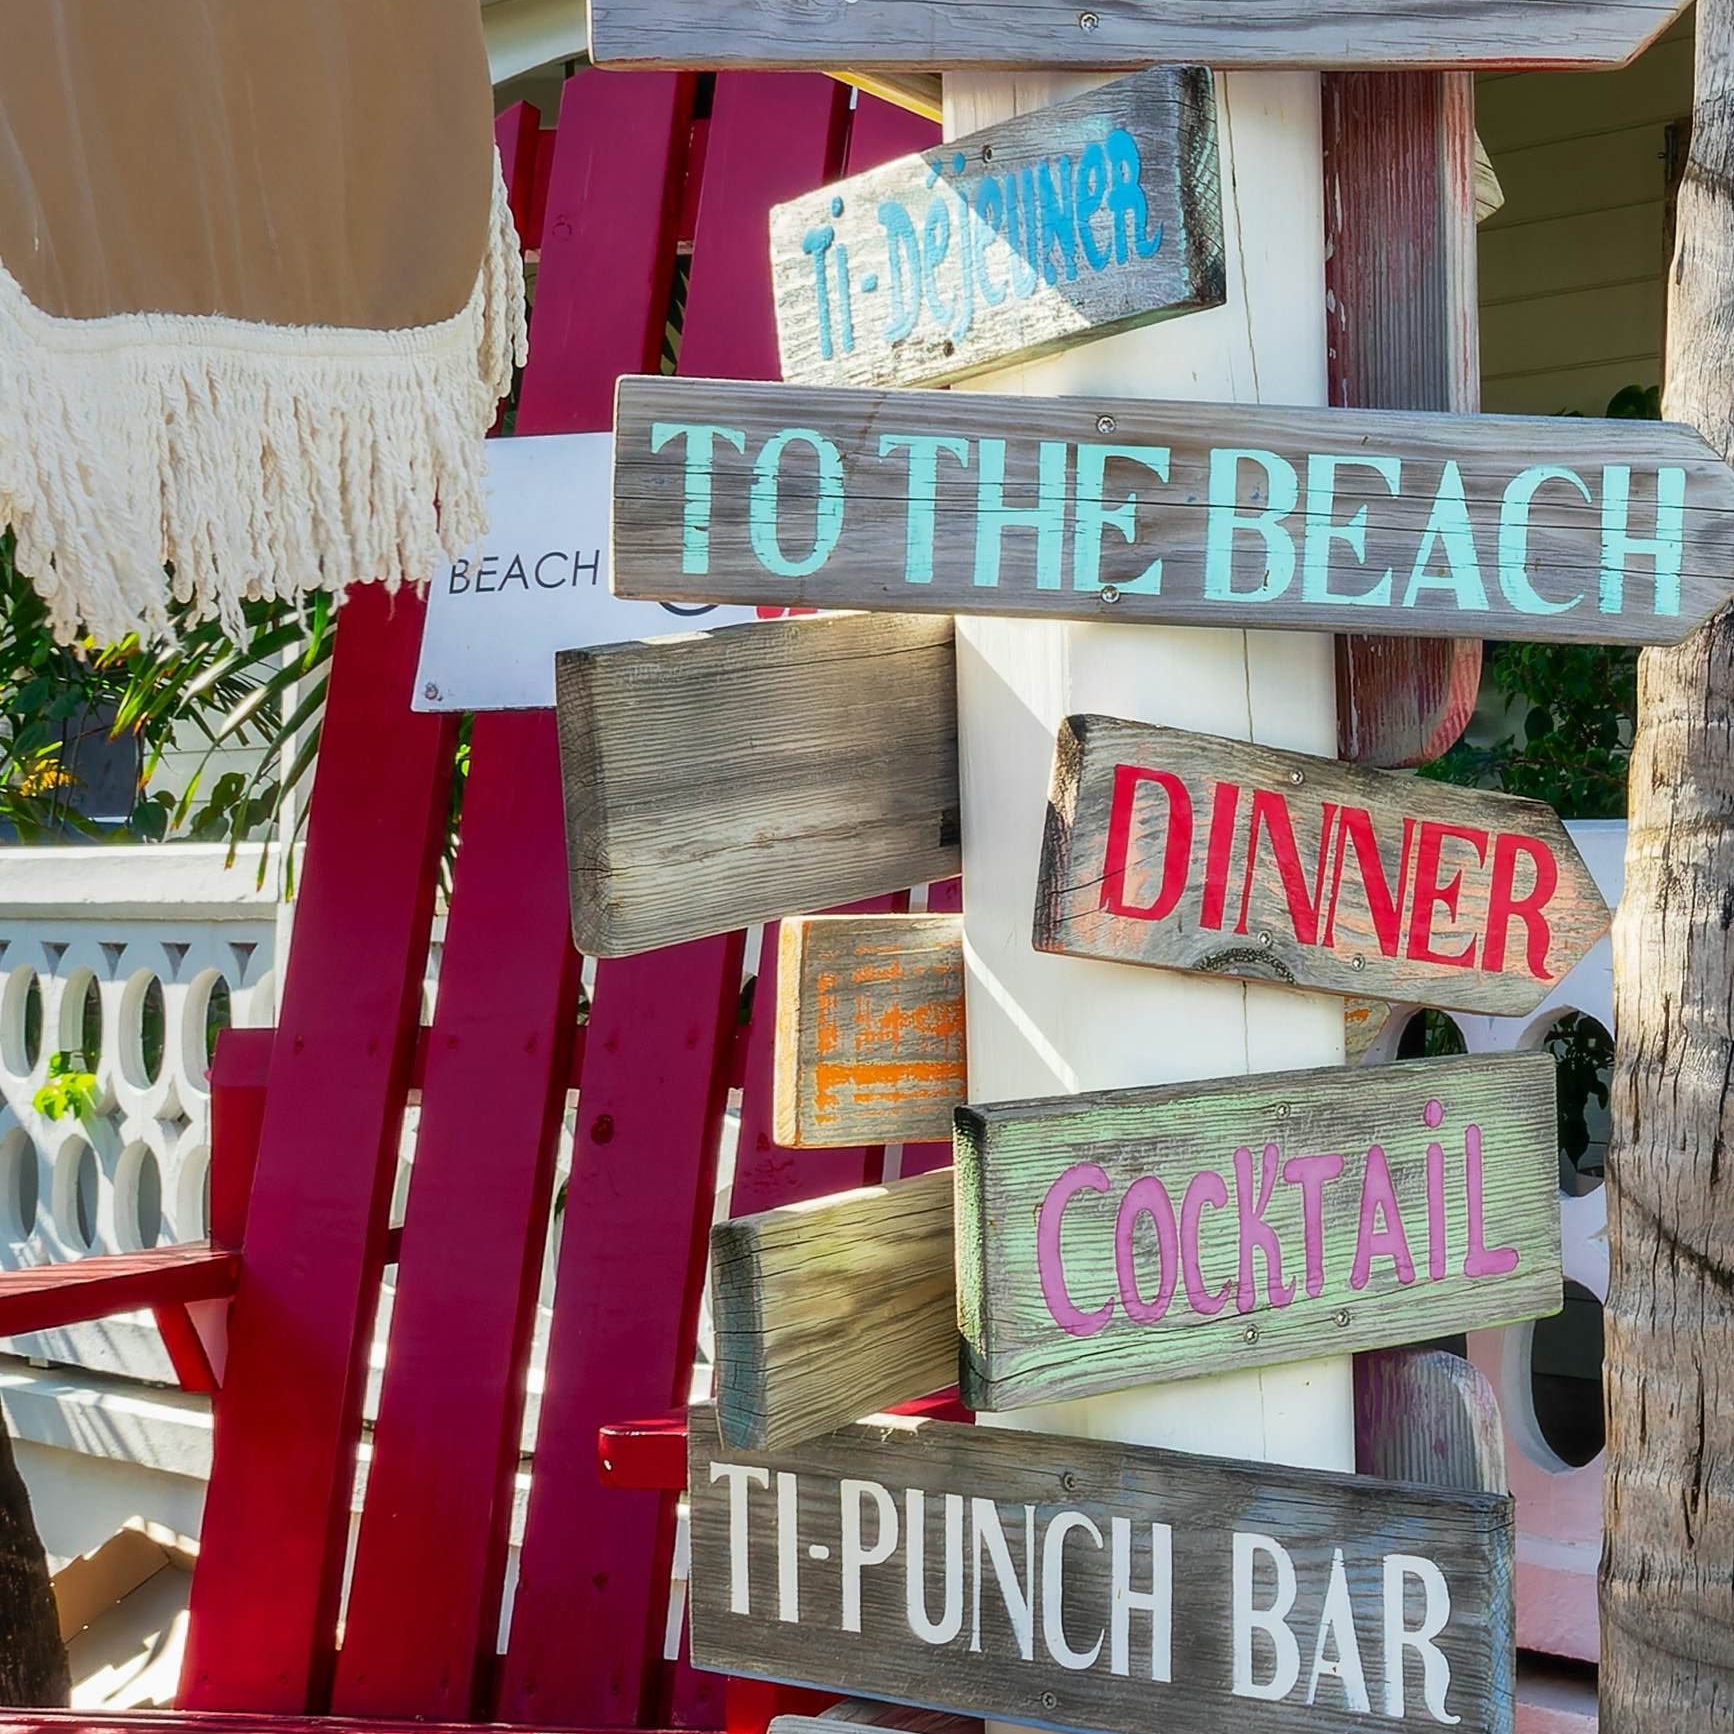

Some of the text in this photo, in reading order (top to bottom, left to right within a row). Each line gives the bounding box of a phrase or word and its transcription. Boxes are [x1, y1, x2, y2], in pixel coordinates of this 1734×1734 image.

[449, 549, 600, 595] BEACH
[650, 422, 1685, 616] TO THE BEACH
[1098, 763, 1558, 981] DINNER
[709, 1461, 1462, 1726] TI-PUNCH BAR
